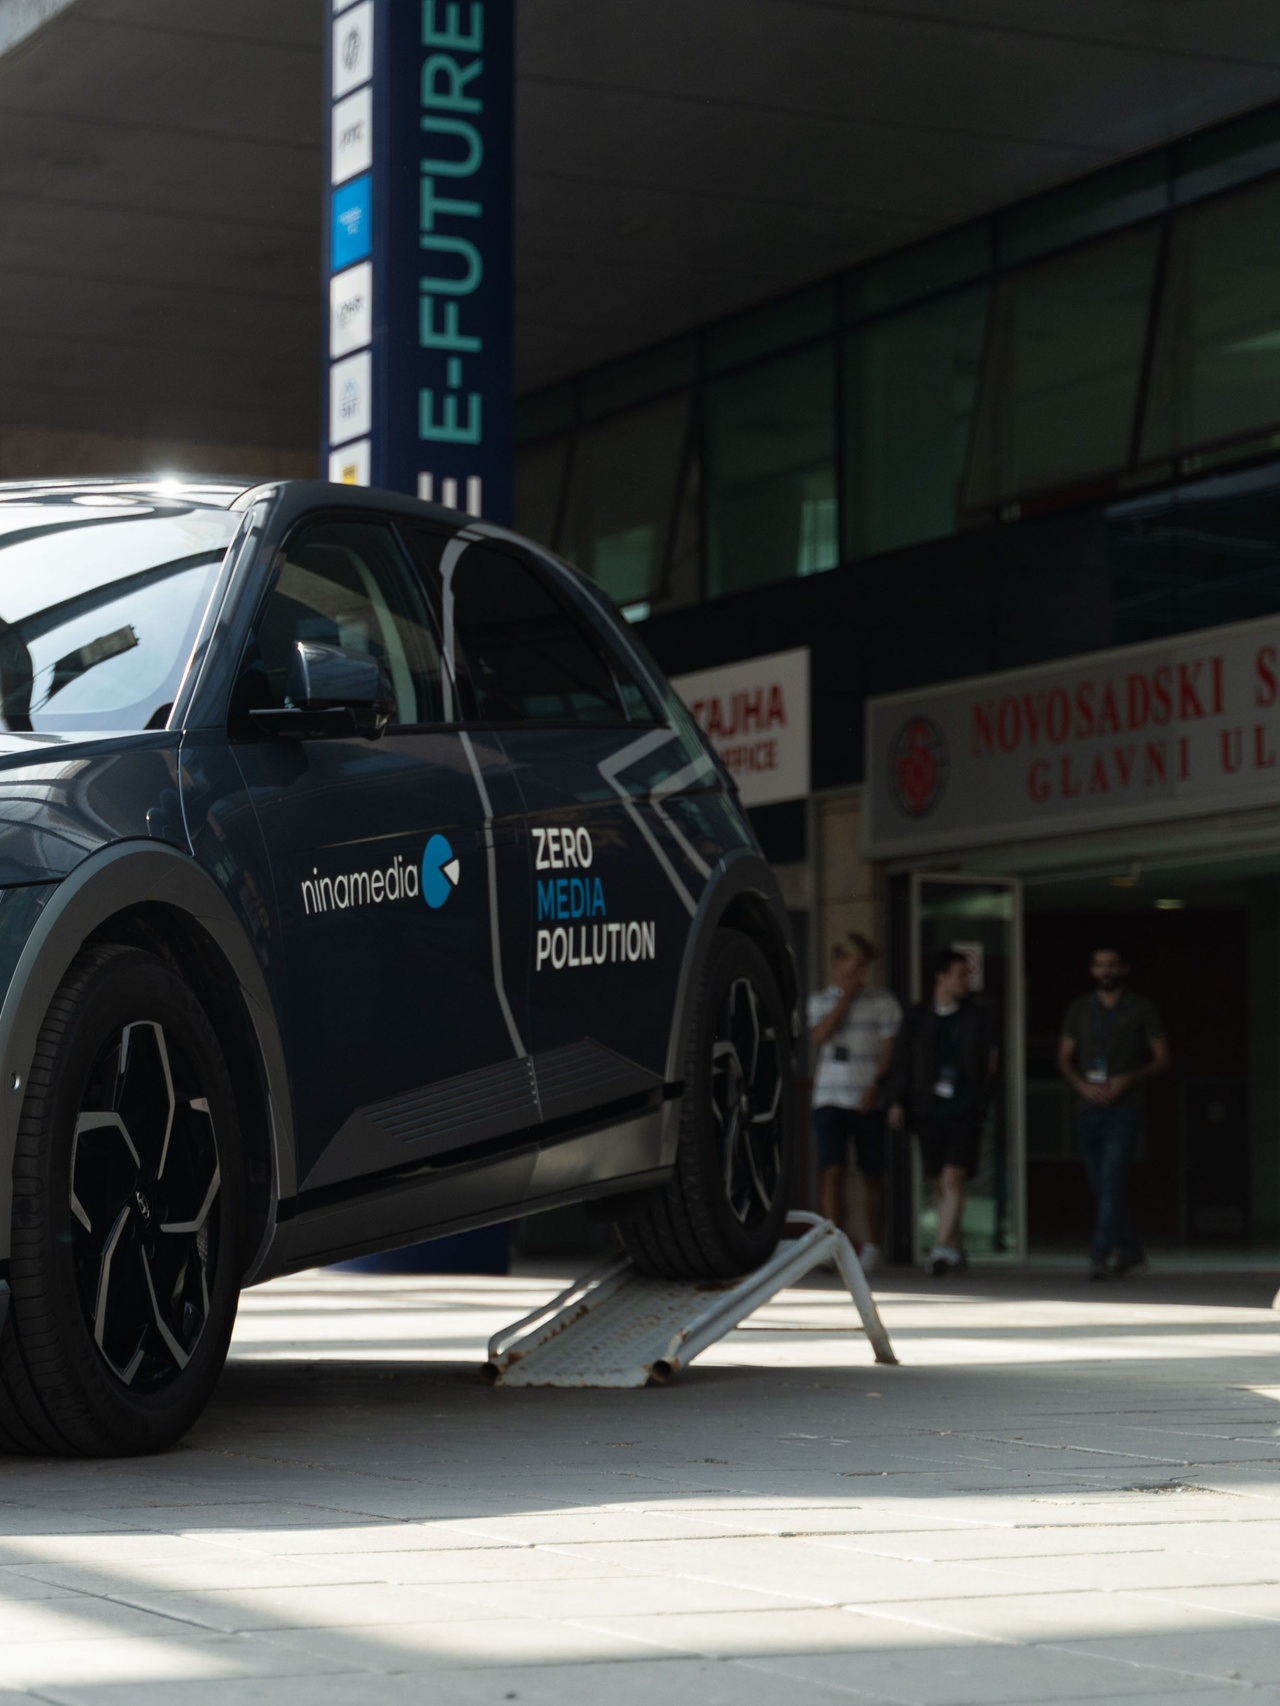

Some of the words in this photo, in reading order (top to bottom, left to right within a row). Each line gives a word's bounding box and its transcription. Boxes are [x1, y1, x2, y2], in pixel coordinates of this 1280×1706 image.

[419, 0, 484, 445] E-FUTURE
[971, 655, 1224, 758] NOVOSADSKI
[1027, 736, 1190, 803] GLAVNI
[531, 826, 593, 870] ZERO
[301, 855, 419, 915] ninamedia
[536, 877, 606, 921] MEDIA
[535, 921, 656, 972] POLLUTION
